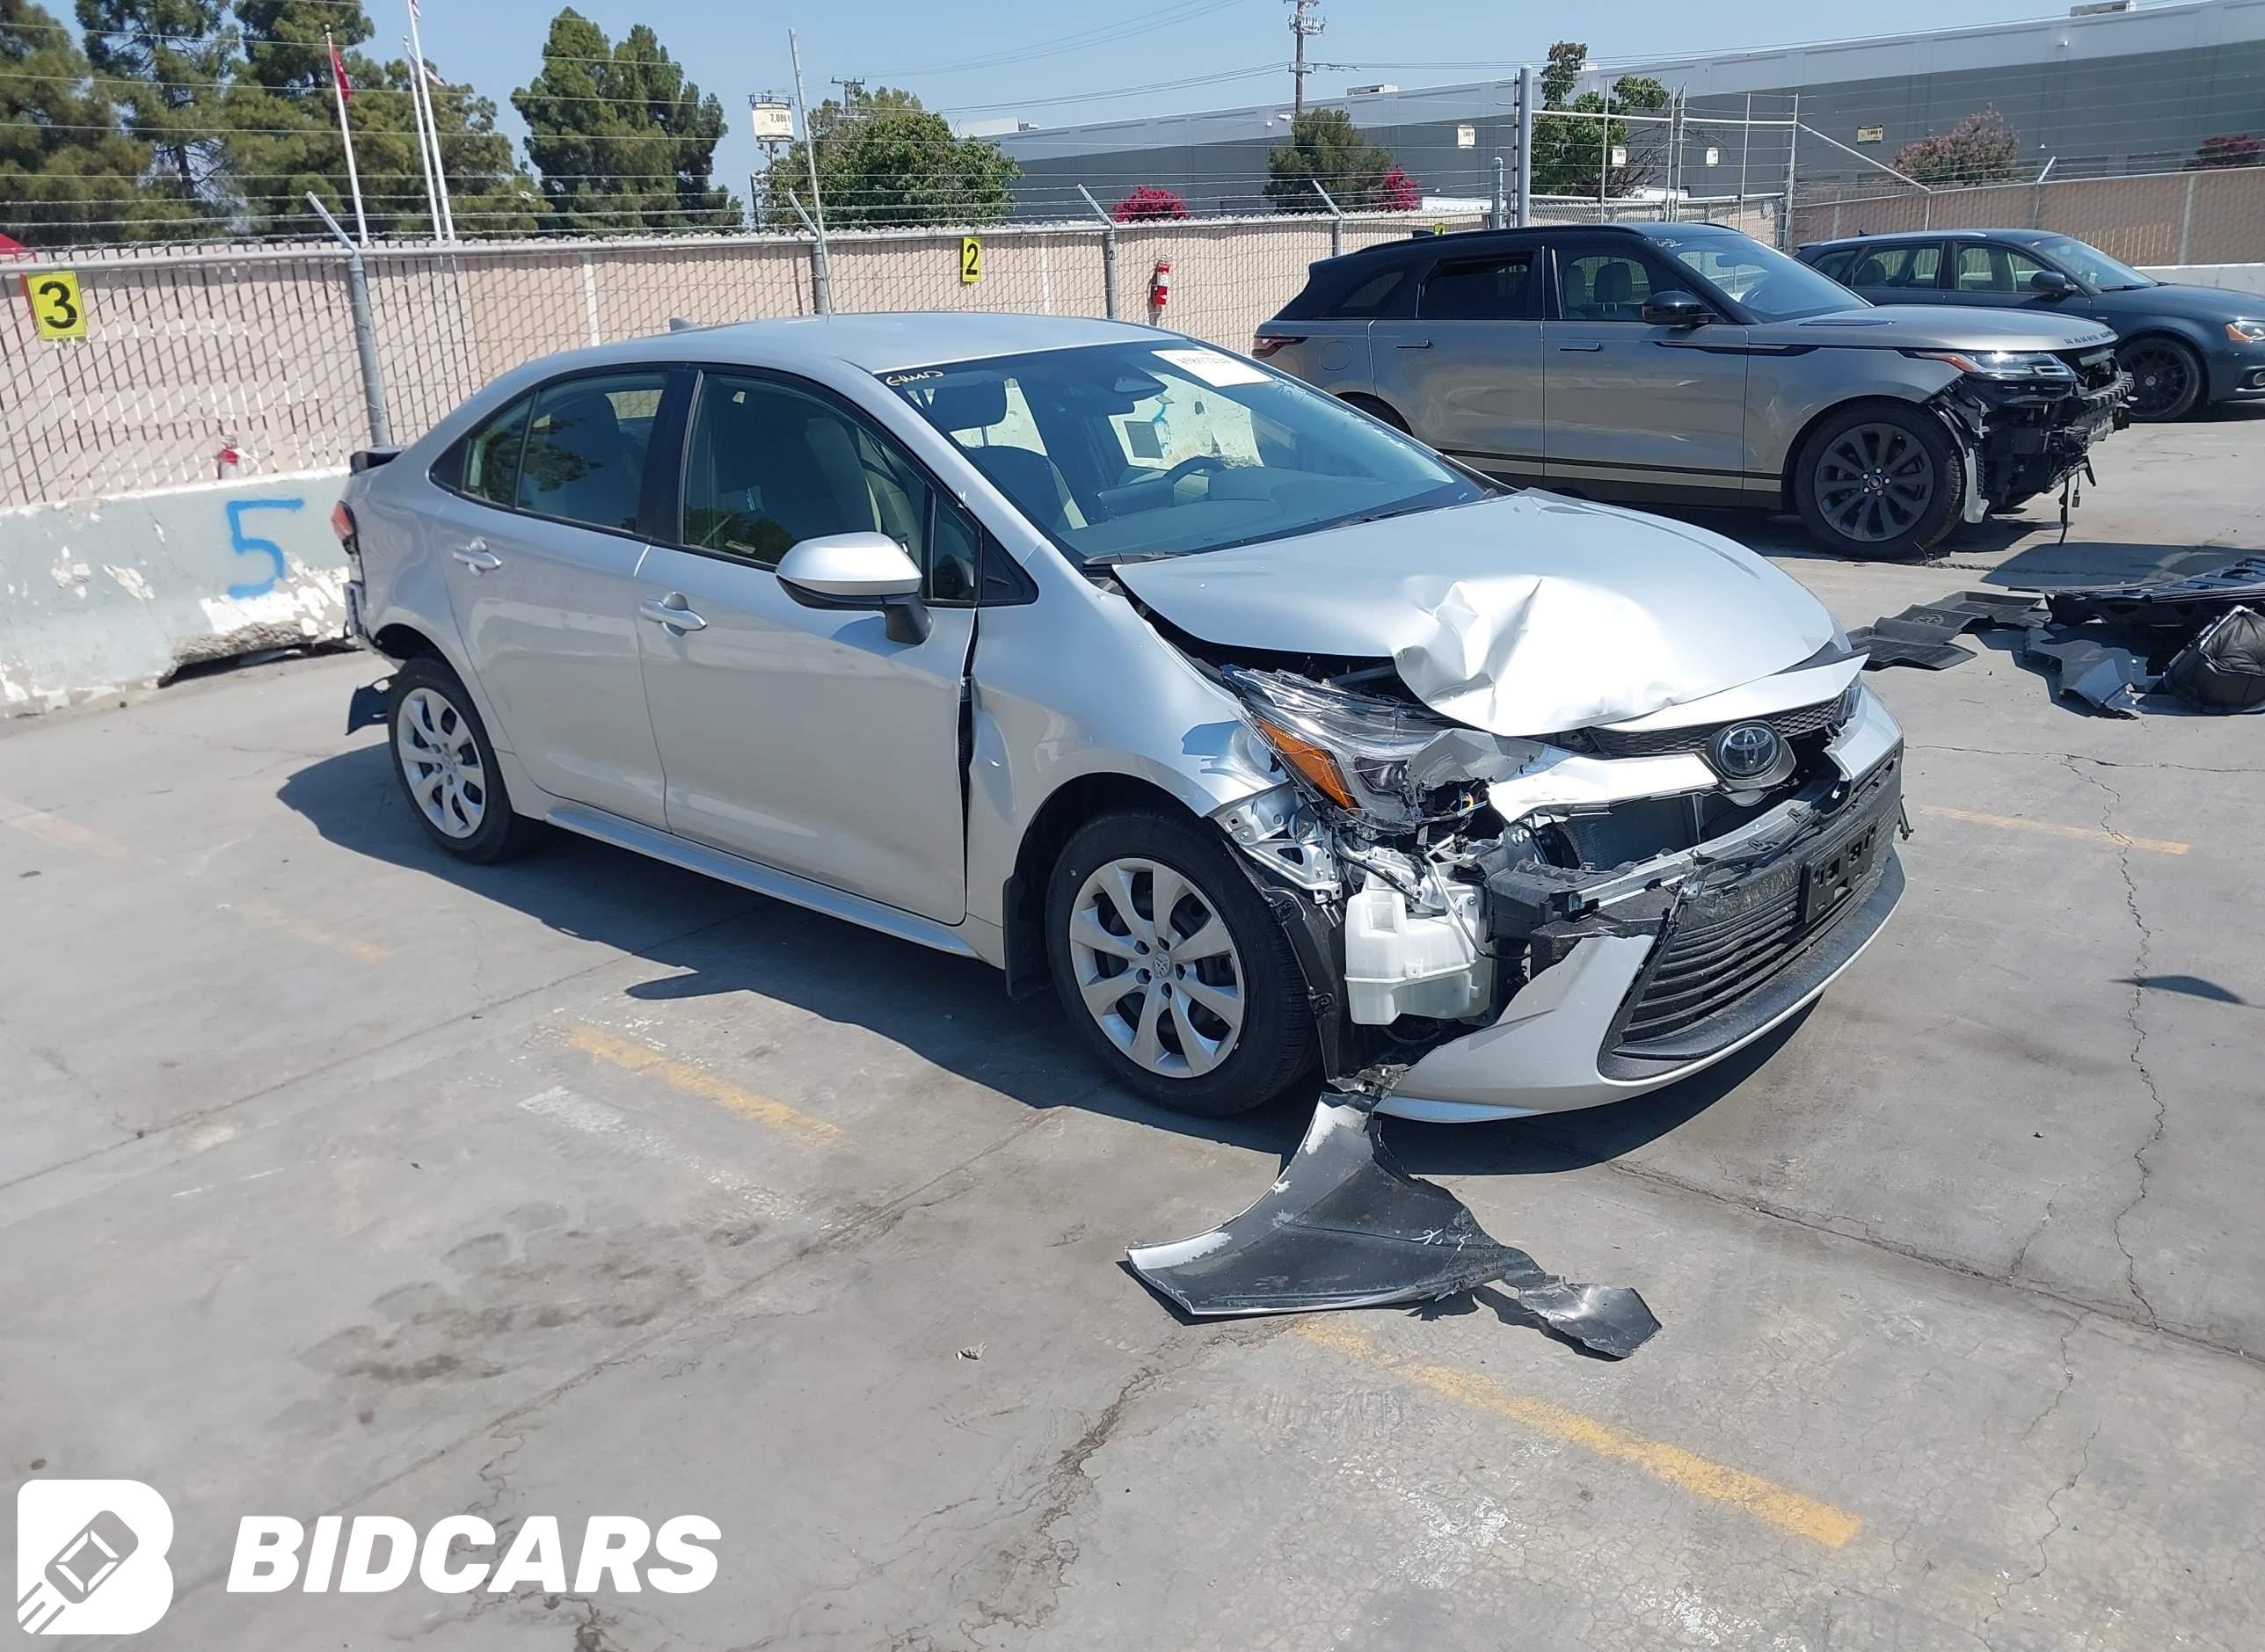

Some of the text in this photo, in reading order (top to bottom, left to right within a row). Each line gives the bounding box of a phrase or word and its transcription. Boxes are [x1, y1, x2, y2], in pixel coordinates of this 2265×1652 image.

[965, 243, 979, 275] 2
[39, 280, 77, 329] 3
[226, 498, 305, 600] 5
